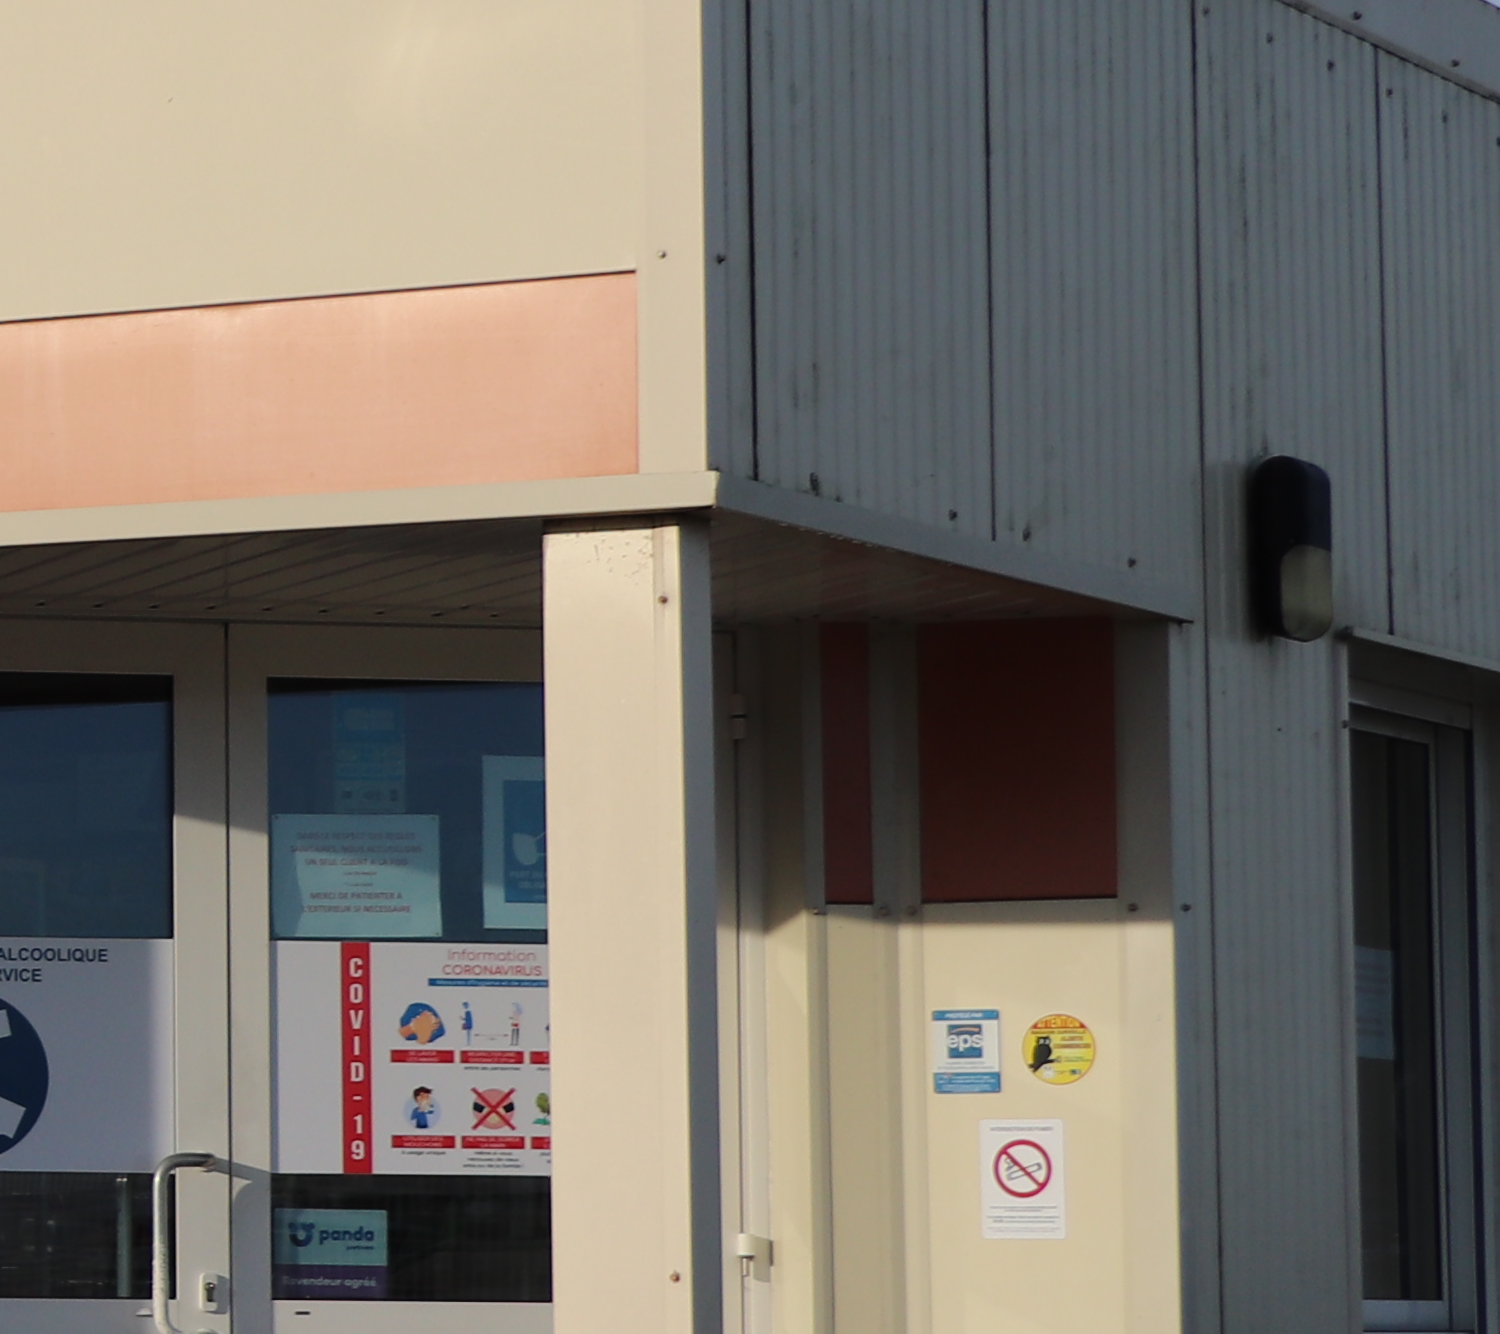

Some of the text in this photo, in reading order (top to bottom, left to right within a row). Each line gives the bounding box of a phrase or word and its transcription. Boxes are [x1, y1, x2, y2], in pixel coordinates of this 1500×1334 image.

[447, 948, 536, 962] Information
[442, 964, 543, 977] CORONAVIRUS
[947, 1034, 984, 1052] eps
[349, 957, 366, 1161] COVID-19
[318, 1225, 375, 1246] panda
[282, 1276, 377, 1289] Revendeur agréé
